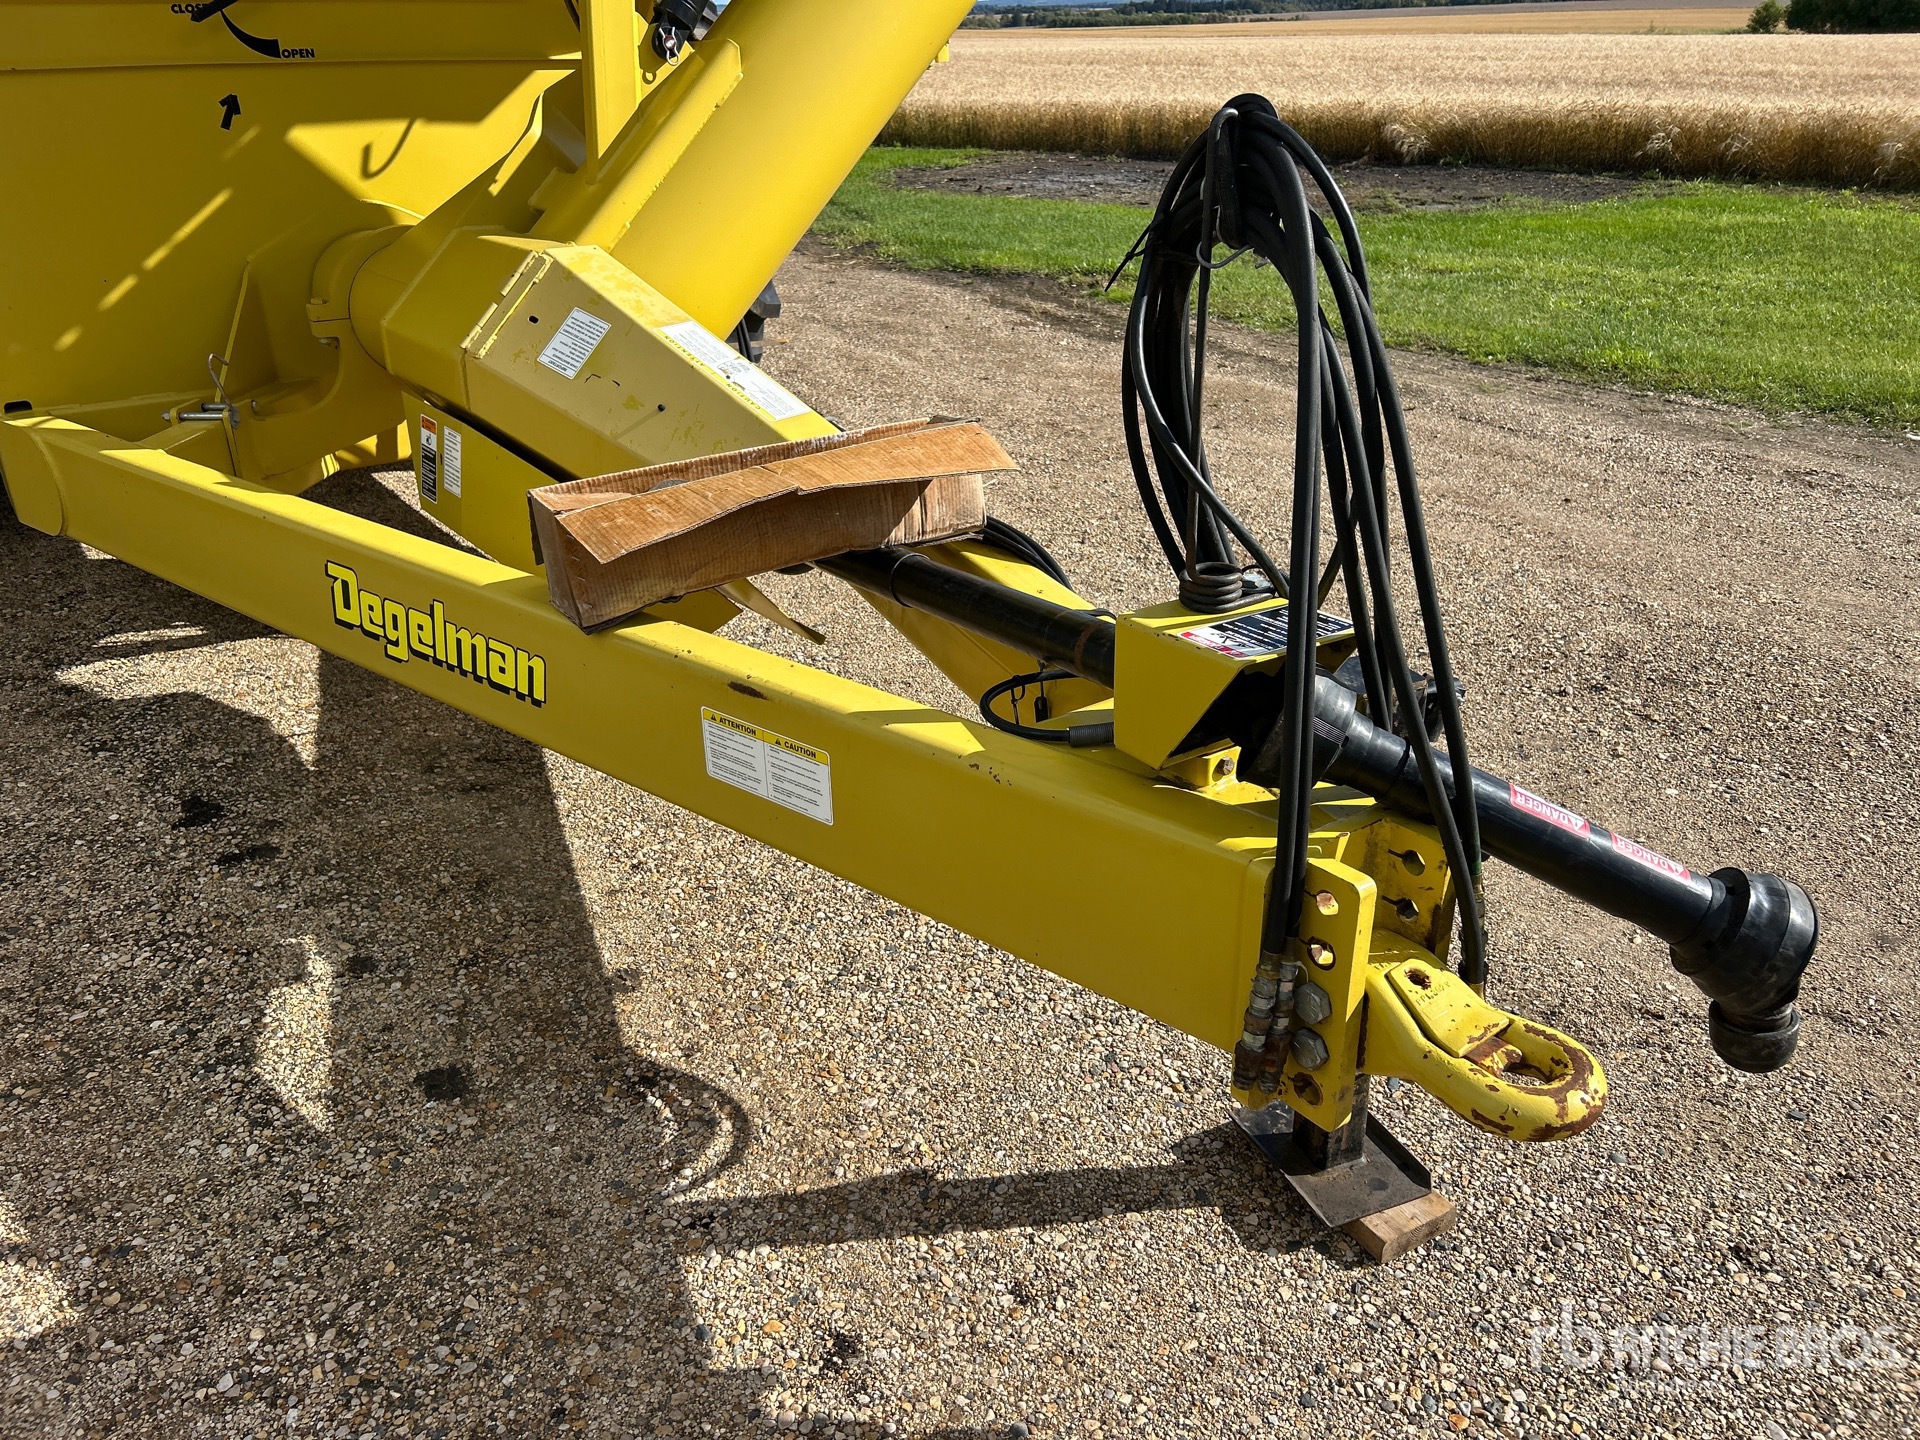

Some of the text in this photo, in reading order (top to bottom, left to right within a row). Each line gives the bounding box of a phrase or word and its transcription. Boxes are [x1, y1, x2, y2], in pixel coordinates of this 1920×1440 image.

[281, 48, 315, 59] OPEN
[663, 334, 706, 367] ATTENTION
[726, 383, 761, 410] CAUTION
[325, 560, 546, 708] Degelman
[719, 717, 757, 736] ATTENTION
[784, 741, 817, 759] CAUTION
[1516, 793, 1569, 824] DANGER
[1616, 836, 1669, 871] DANGER
